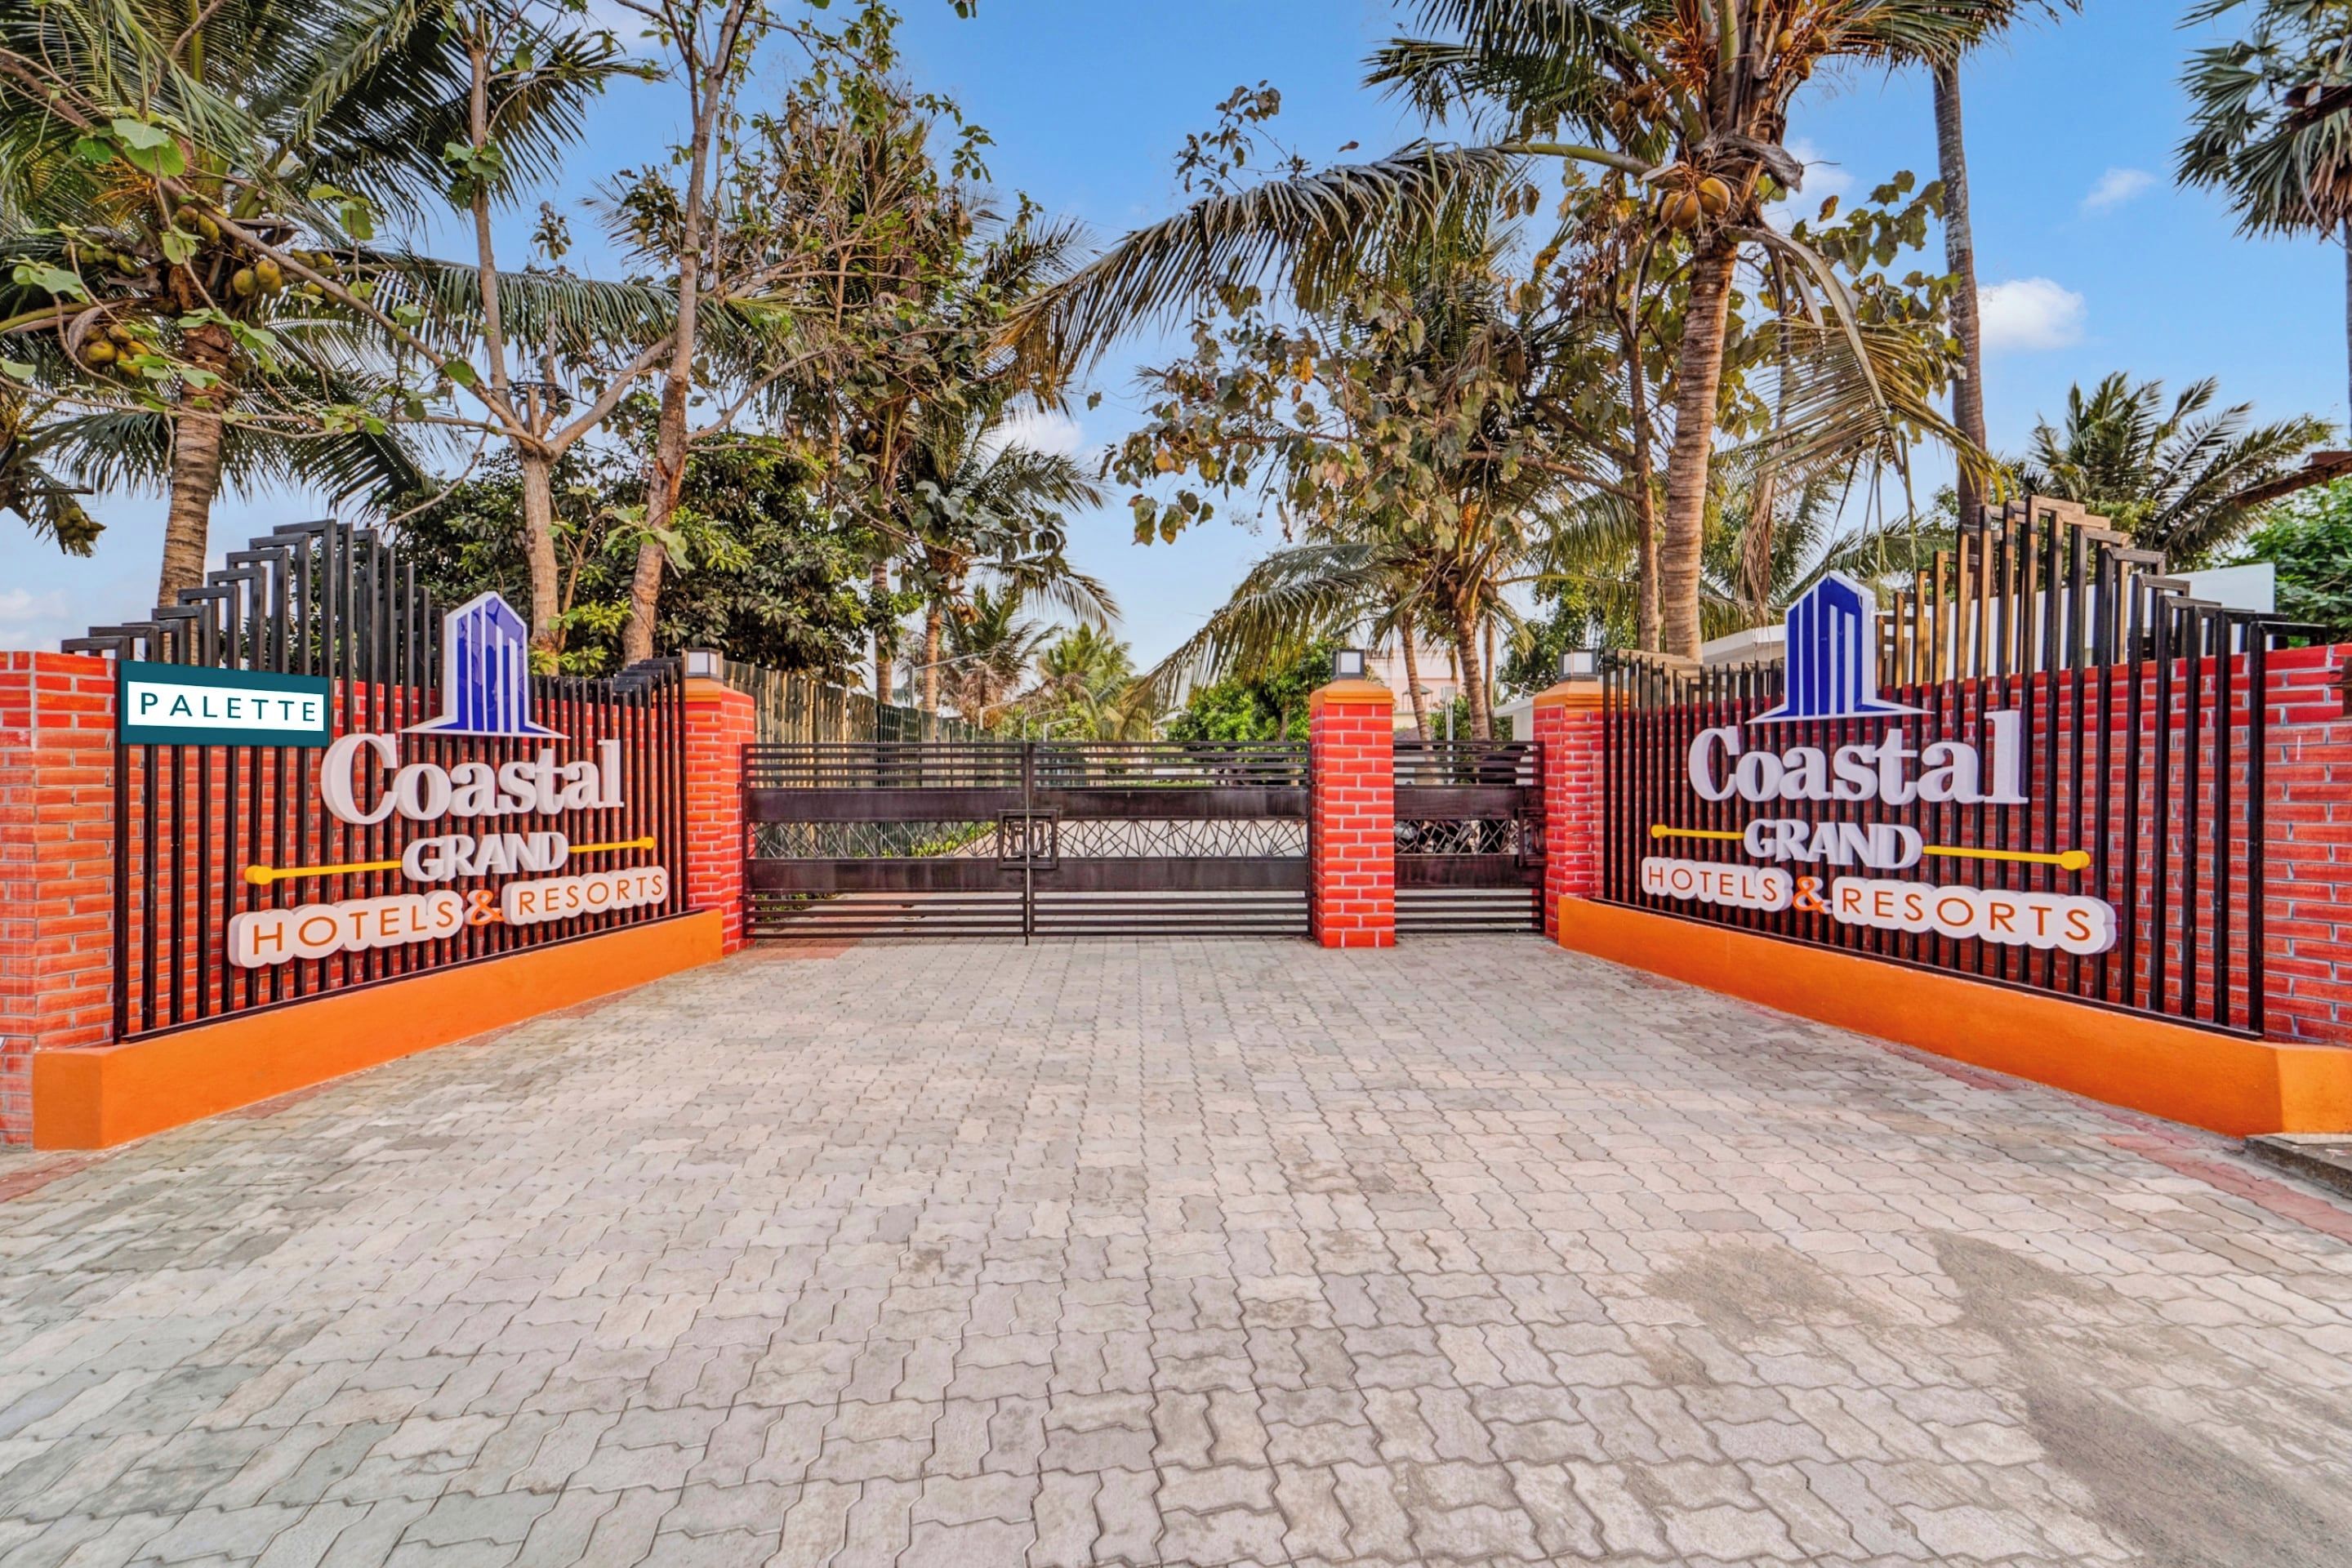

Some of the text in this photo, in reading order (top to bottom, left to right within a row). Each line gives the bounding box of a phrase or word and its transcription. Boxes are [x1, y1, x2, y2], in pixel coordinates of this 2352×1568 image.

[140, 692, 316, 723] PALETTE
[320, 732, 625, 826] Coastal
[1688, 710, 2029, 805] Coastal
[401, 831, 570, 883] GRAND
[1744, 818, 1923, 869] GRAND
[252, 874, 665, 957] HOTELS & RESORTS
[1647, 865, 2092, 942] HOTELS & RESORTS
